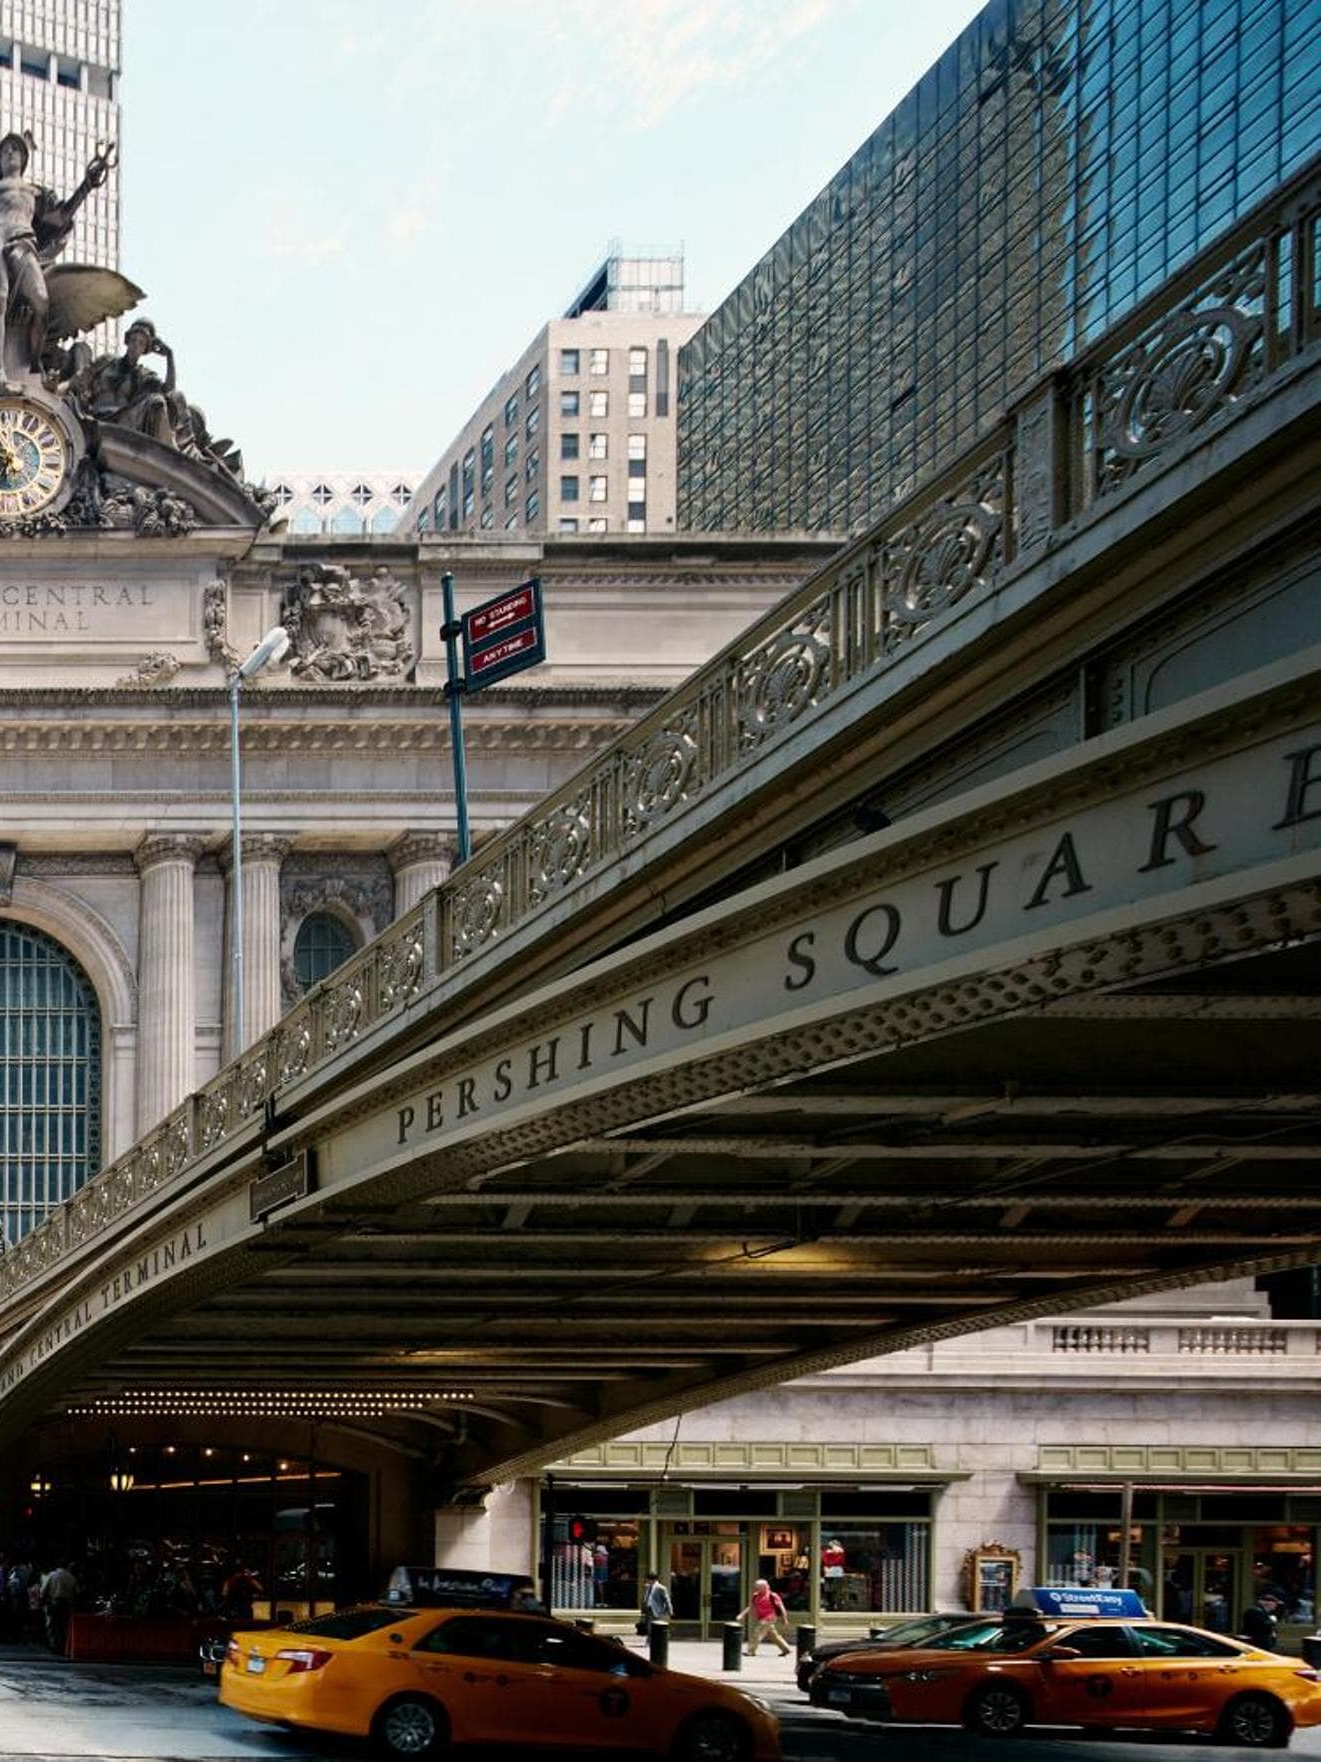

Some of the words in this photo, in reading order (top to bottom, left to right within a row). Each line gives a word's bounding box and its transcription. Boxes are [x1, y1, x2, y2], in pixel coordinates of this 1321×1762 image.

[1, 585, 155, 606] CENTRAL
[474, 615, 488, 627] NO
[397, 975, 715, 1145] PERSHING
[784, 742, 1321, 992] SQUARE
[29, 1301, 93, 1367] CENTRAL
[101, 1221, 208, 1309] TERMINAL
